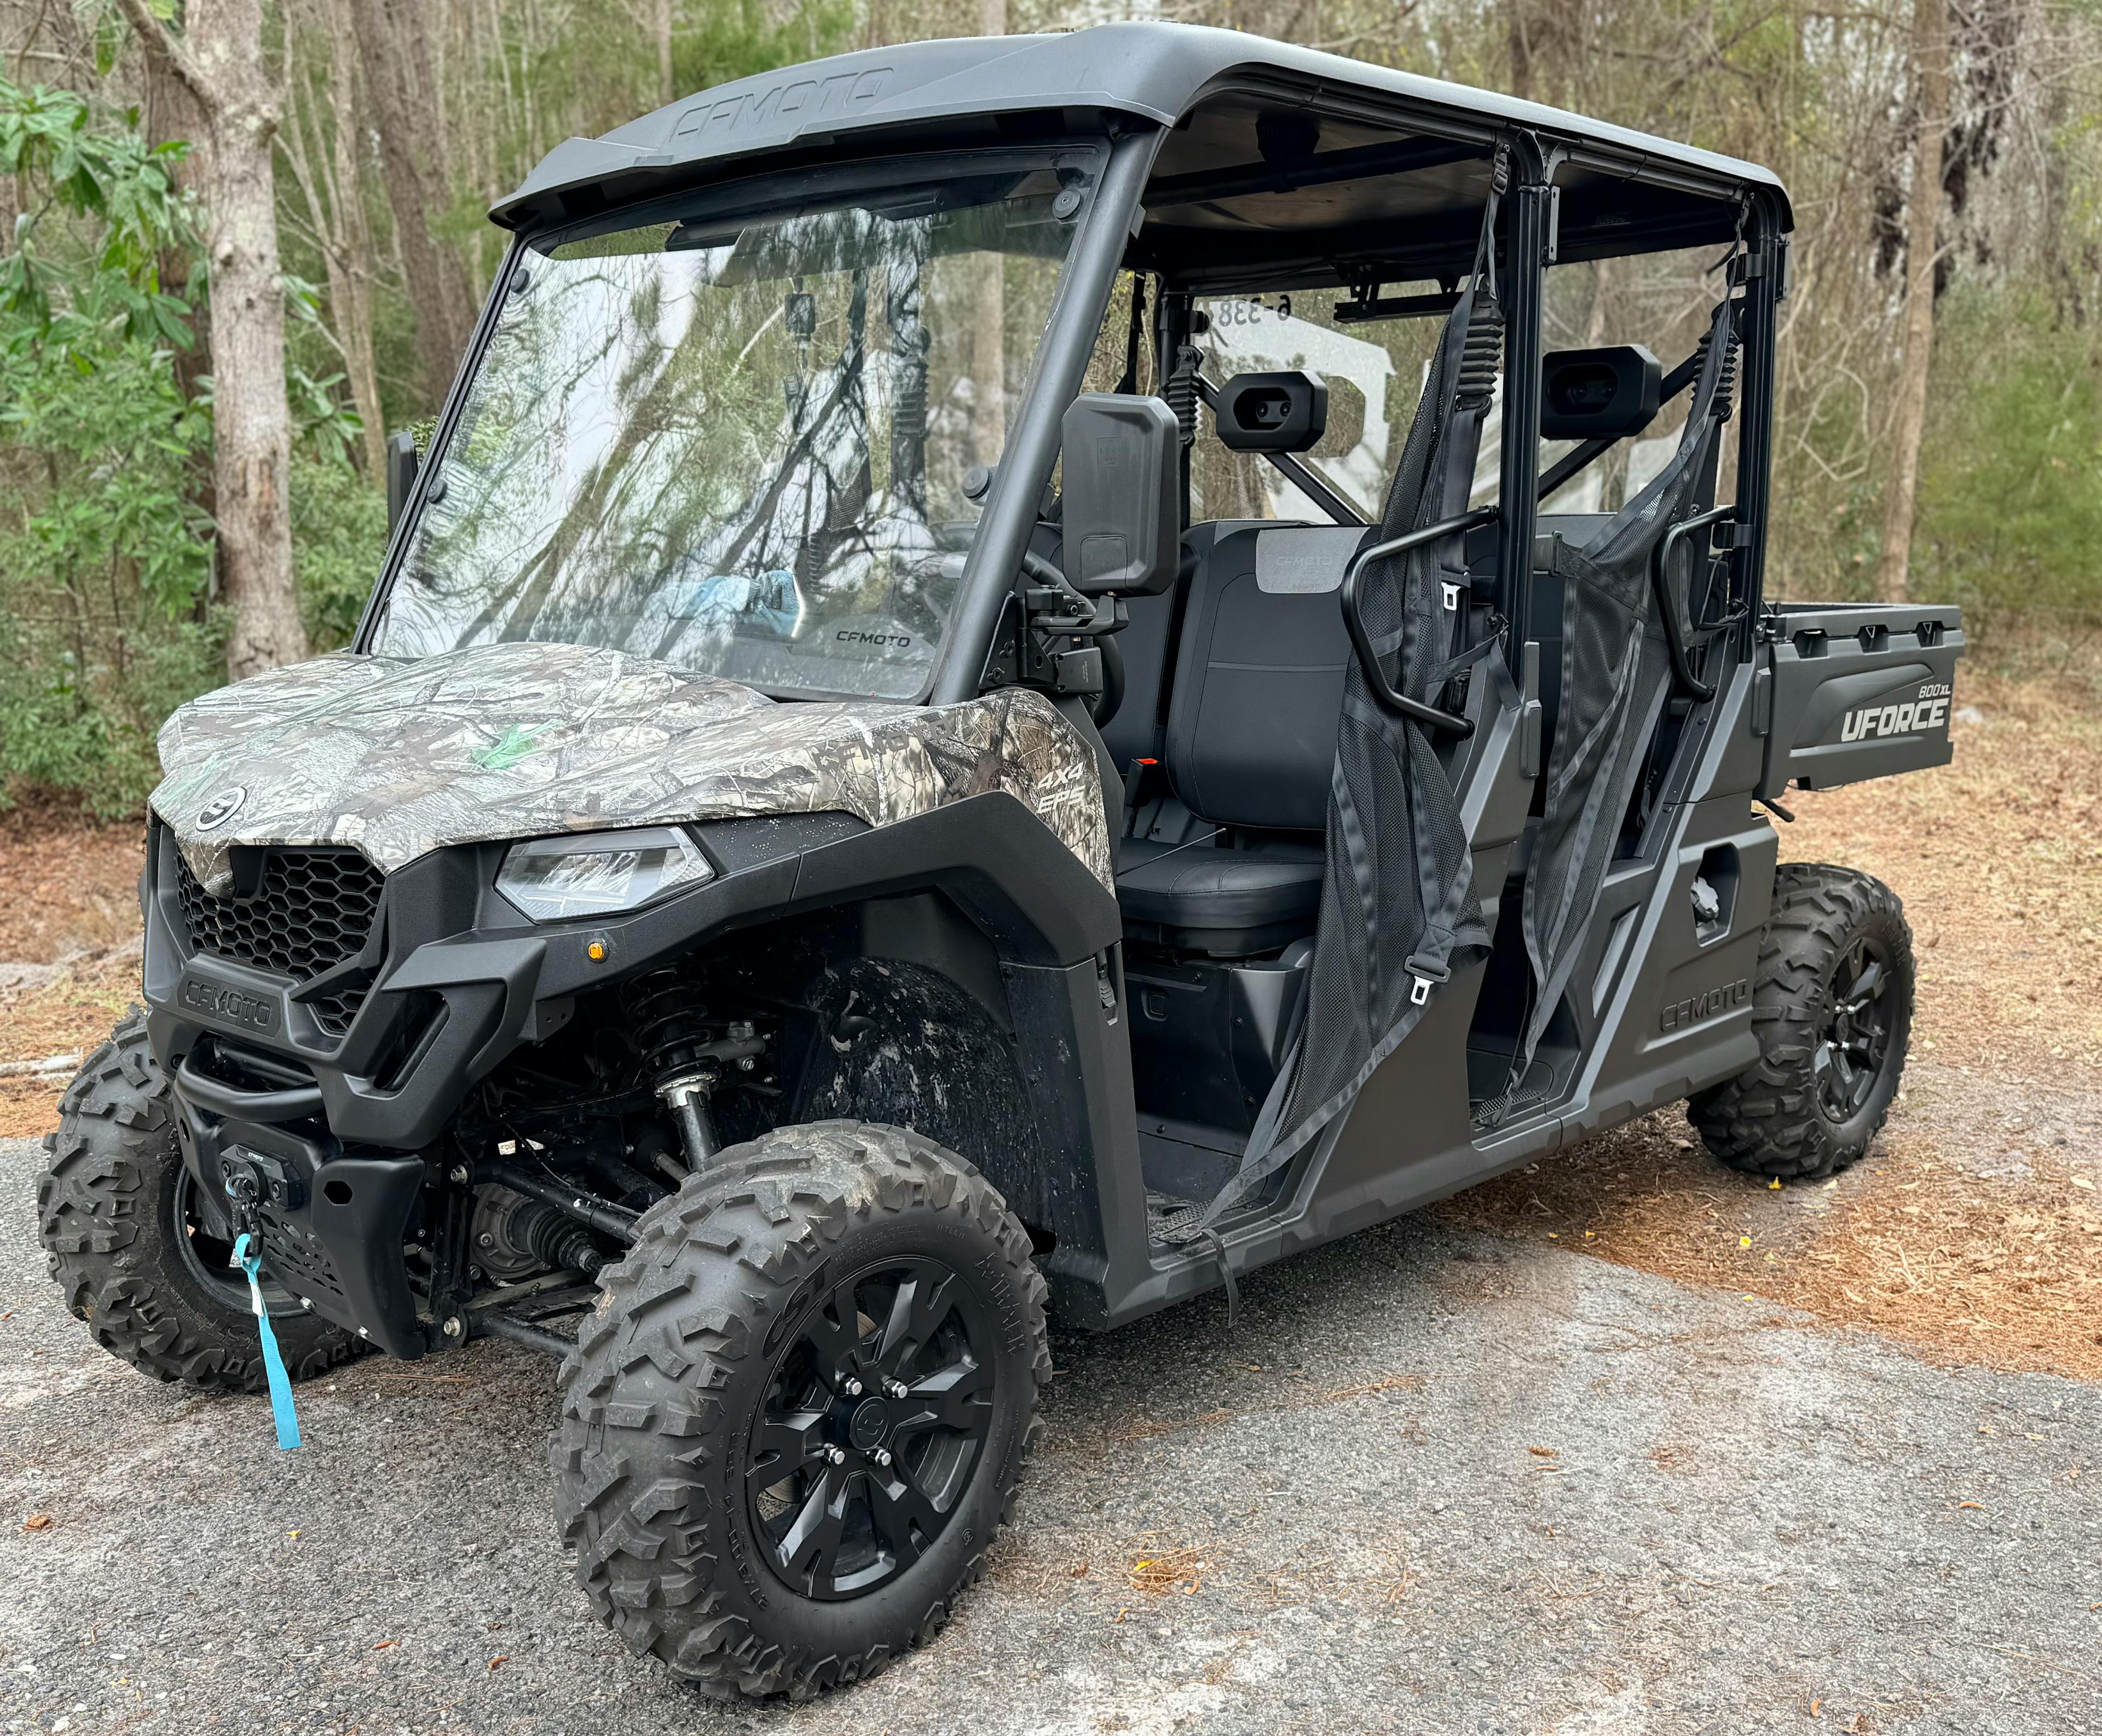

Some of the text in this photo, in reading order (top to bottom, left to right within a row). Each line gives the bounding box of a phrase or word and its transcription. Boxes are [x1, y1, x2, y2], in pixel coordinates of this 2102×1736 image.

[669, 67, 894, 142] CFMOTO
[836, 631, 911, 648] CFMOTO
[1841, 697, 1949, 742] UFORCE
[1038, 762, 1086, 789] 4X4
[1037, 785, 1085, 814] EPS
[185, 980, 271, 1026] CFMOTO
[1660, 978, 1747, 1031] CFMOTO
[761, 1255, 832, 1360] CST
